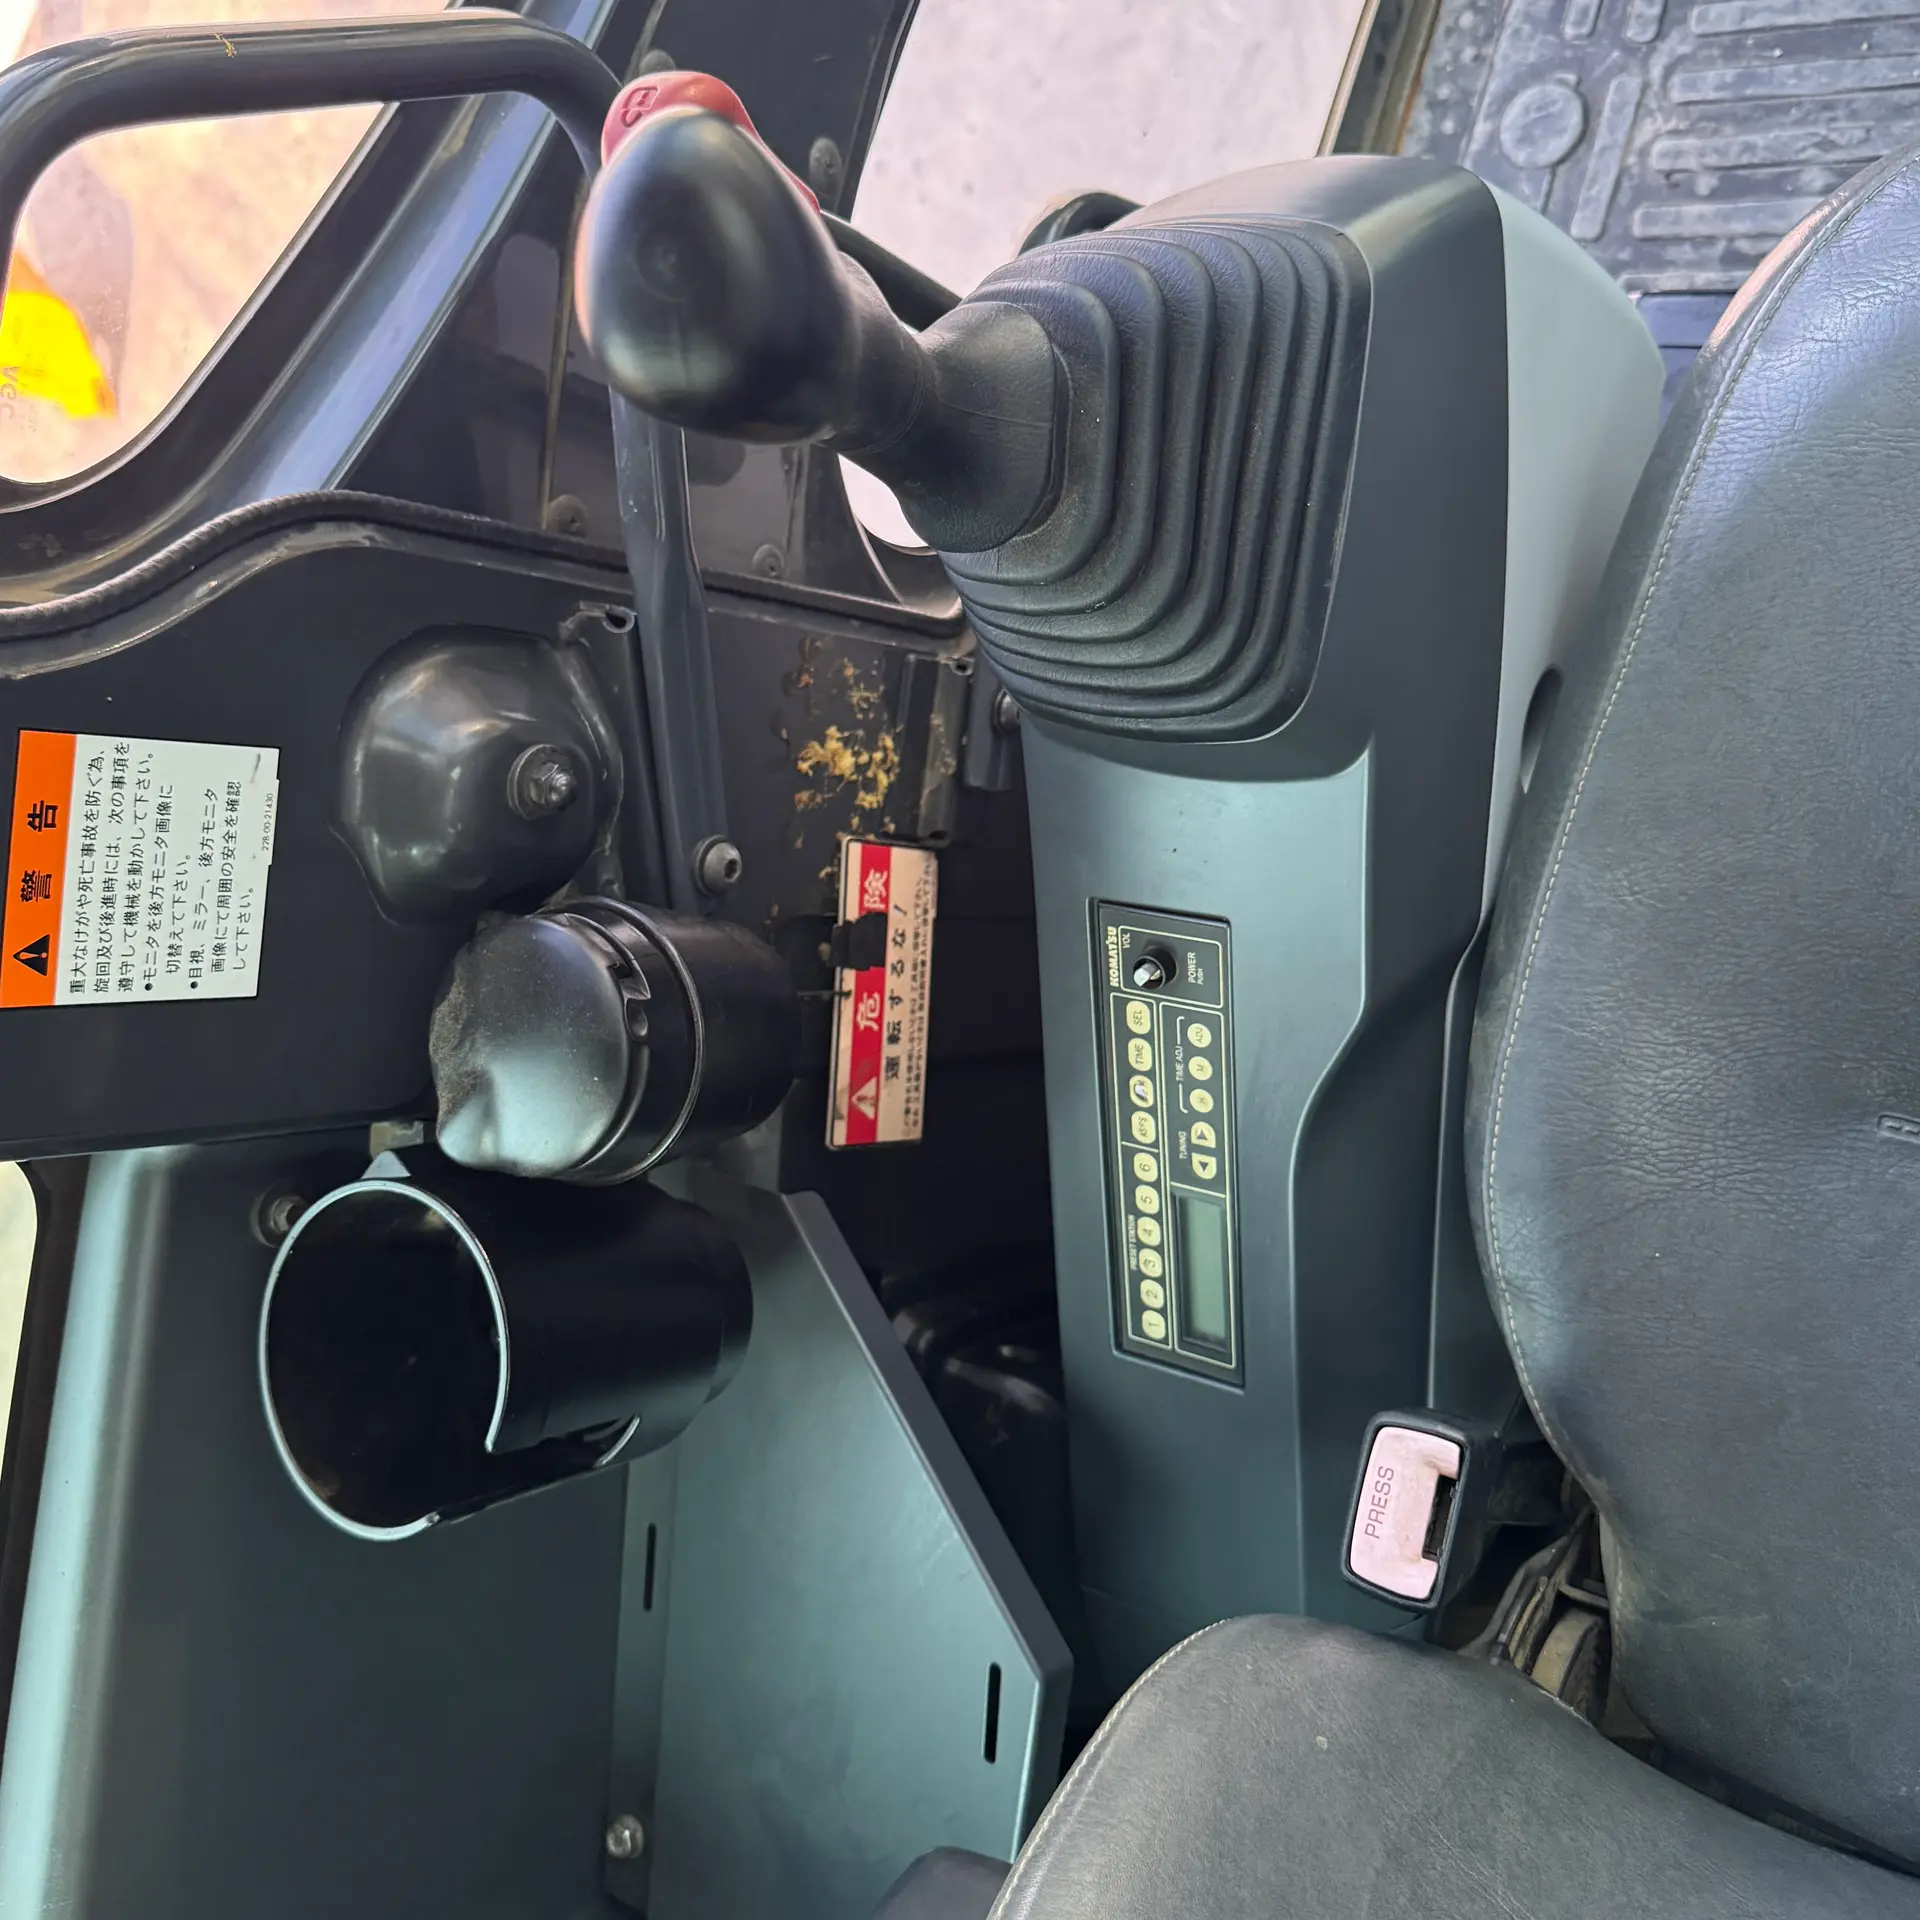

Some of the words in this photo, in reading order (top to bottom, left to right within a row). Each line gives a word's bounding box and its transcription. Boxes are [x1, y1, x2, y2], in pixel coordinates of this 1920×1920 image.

[20, 800, 58, 902] 警告
[70, 750, 106, 994] 重大なけがや死亡事故を防ぐ為、
[117, 753, 154, 992] 遵守して機械を動かして下さい。
[210, 781, 241, 973] 画像にて周囲の安全を確認
[165, 854, 191, 974] 切替えて下さい。
[233, 887, 254, 970] して下さい。
[1122, 932, 1131, 949] VOL
[1105, 926, 1120, 987] KOMATSU
[1187, 952, 1196, 983] POWER
[1133, 1009, 1143, 1026] SEL
[1195, 1027, 1203, 1044] ADJ
[1135, 1043, 1145, 1065] TIME
[1179, 1131, 1188, 1159] TUNING
[1139, 1162, 1151, 1172] 6
[1141, 1194, 1152, 1205] 5
[1142, 1227, 1154, 1237] 4
[1144, 1258, 1156, 1268] 3
[1145, 1289, 1158, 1299] 2
[1364, 1466, 1395, 1539] PRESS
